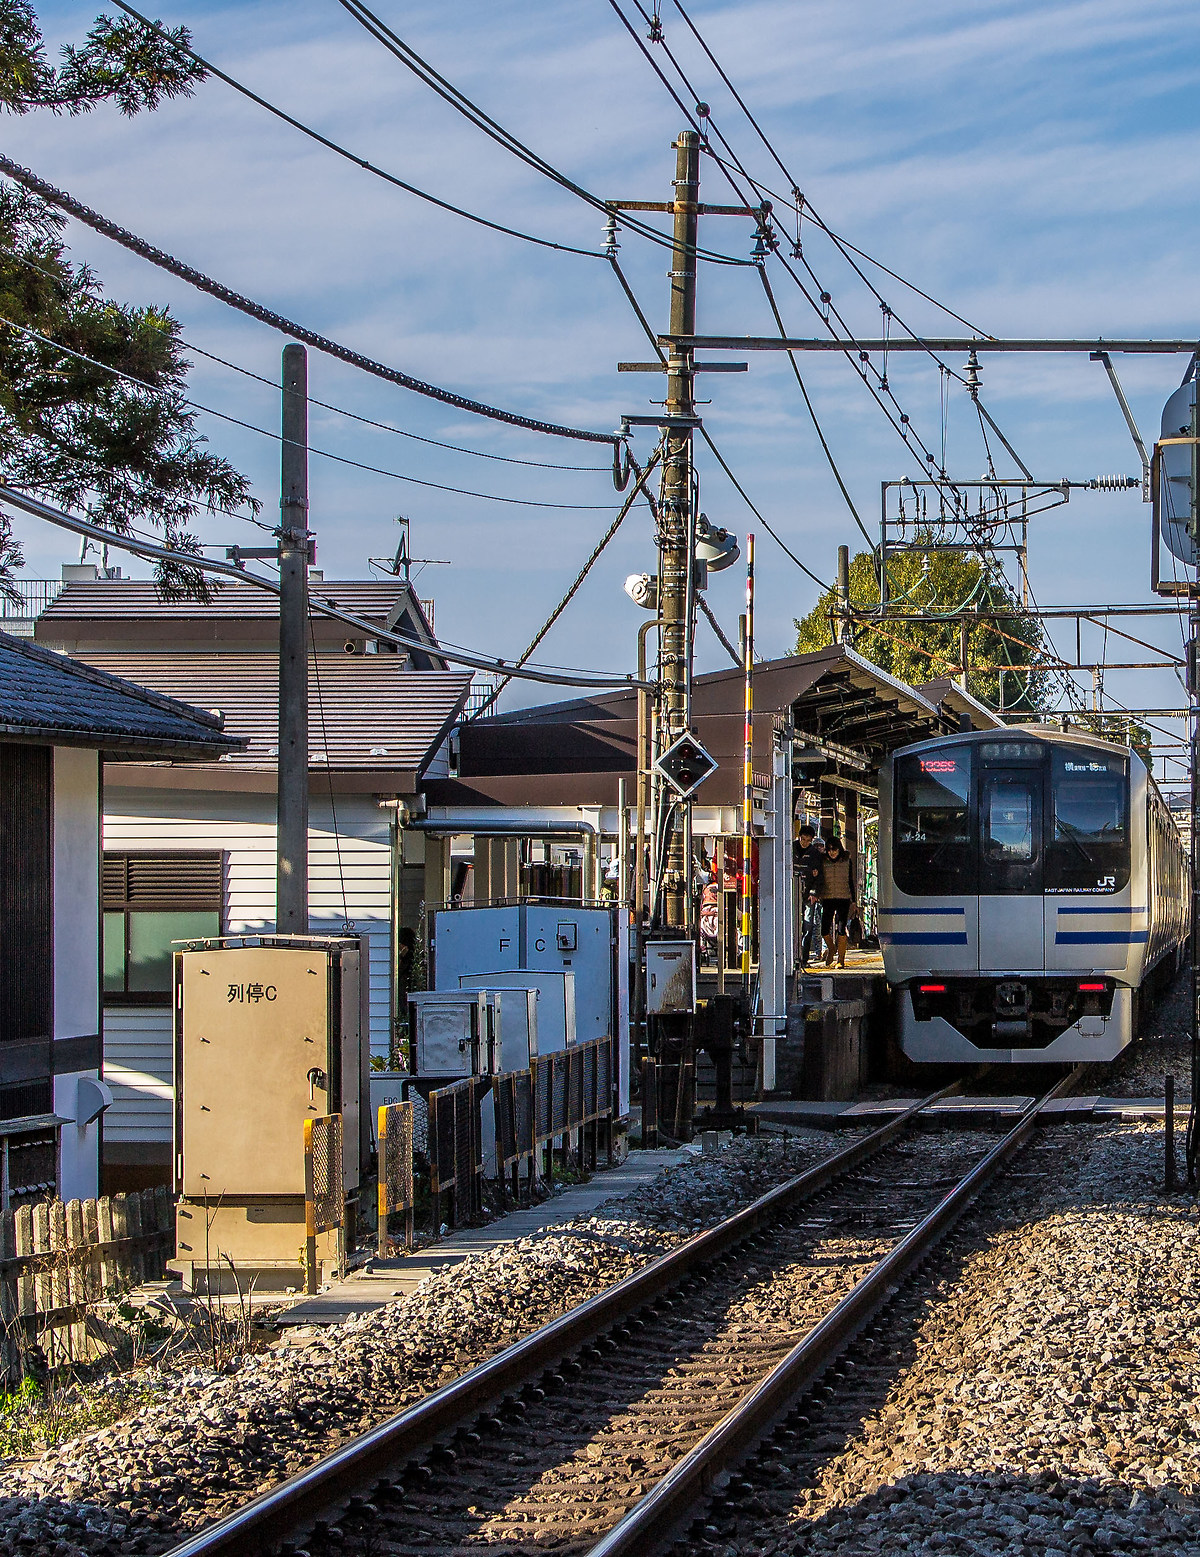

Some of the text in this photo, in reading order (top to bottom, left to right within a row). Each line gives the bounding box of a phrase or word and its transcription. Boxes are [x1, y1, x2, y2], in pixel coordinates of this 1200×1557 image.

[1097, 876, 1115, 886] JR
[500, 938, 546, 952] F C
[227, 982, 277, 1003] 列停C
